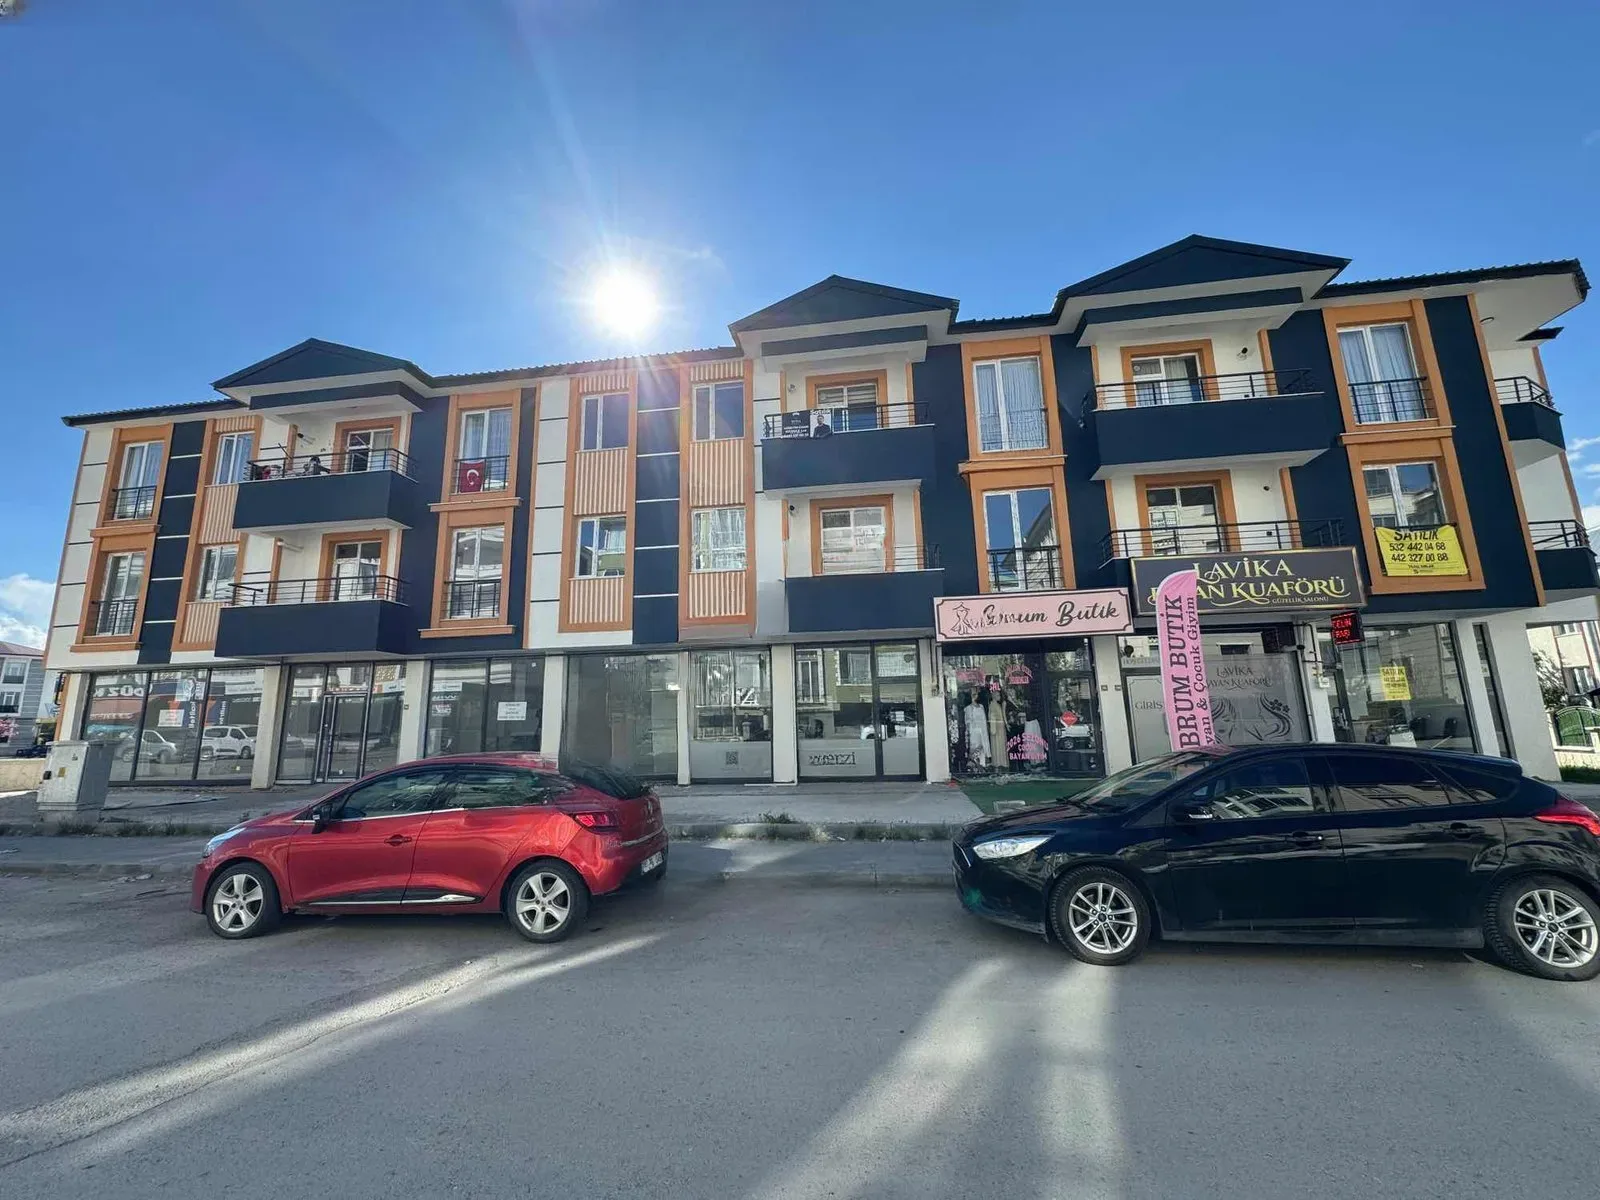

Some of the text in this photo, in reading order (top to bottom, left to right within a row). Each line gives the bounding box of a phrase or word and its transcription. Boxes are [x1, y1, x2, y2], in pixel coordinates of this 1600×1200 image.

[1389, 543, 1405, 551] 532
[1407, 543, 1423, 551] 442
[1394, 529, 1439, 541] SATILIK
[1192, 557, 1295, 584] LAVİKA
[1391, 554, 1406, 562] 442
[1408, 553, 1423, 562] 327
[1211, 576, 1351, 606] KUAFÖRÜ
[1055, 601, 1120, 627] Butik
[1159, 594, 1201, 749] BRUM BUTİK
[1185, 597, 1216, 745] yan & Çocuk Giyim
